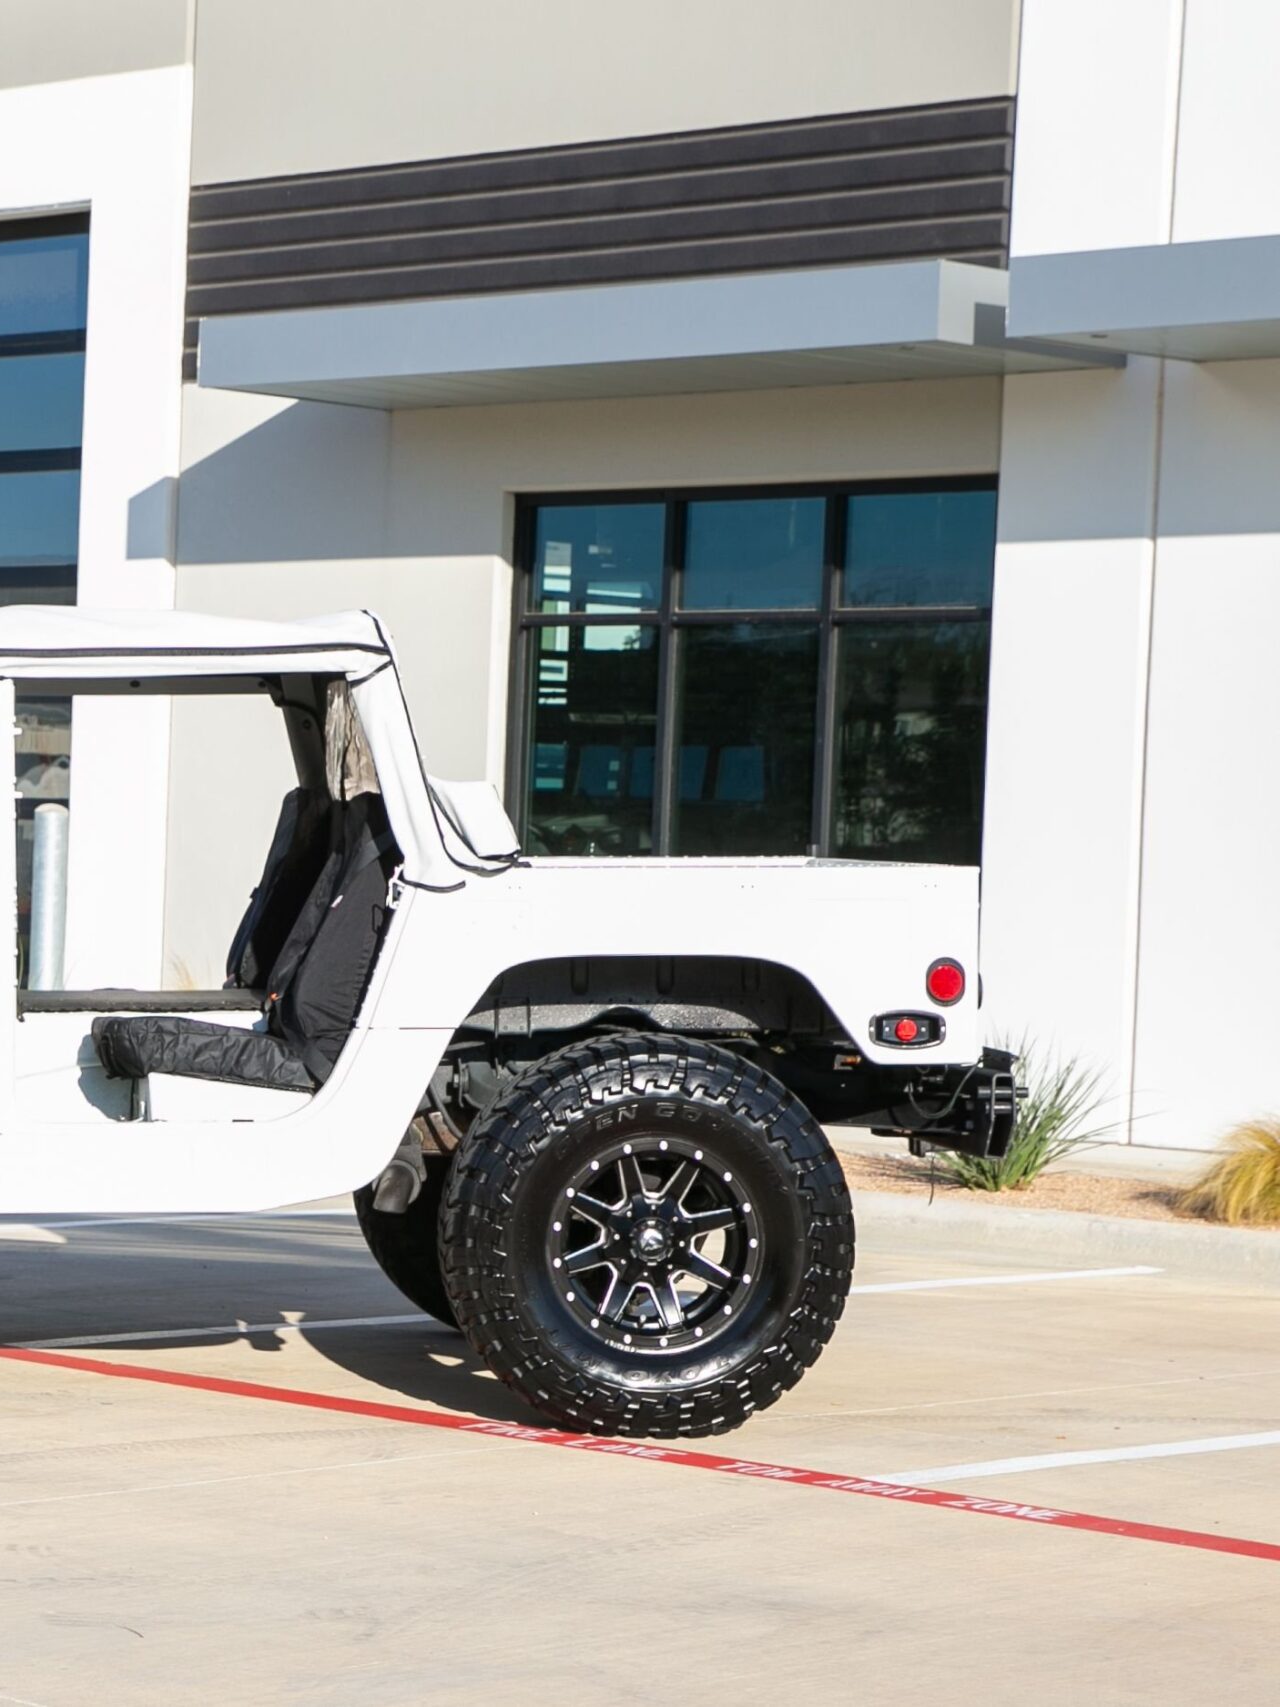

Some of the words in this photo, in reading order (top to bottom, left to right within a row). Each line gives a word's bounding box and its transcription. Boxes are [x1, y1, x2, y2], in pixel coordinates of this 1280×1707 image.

[459, 1422, 565, 1440] FIRE
[564, 1439, 688, 1459] LANE
[716, 1462, 811, 1478] TOW
[813, 1479, 936, 1497] AWAY
[939, 1497, 1077, 1521] ZONE
